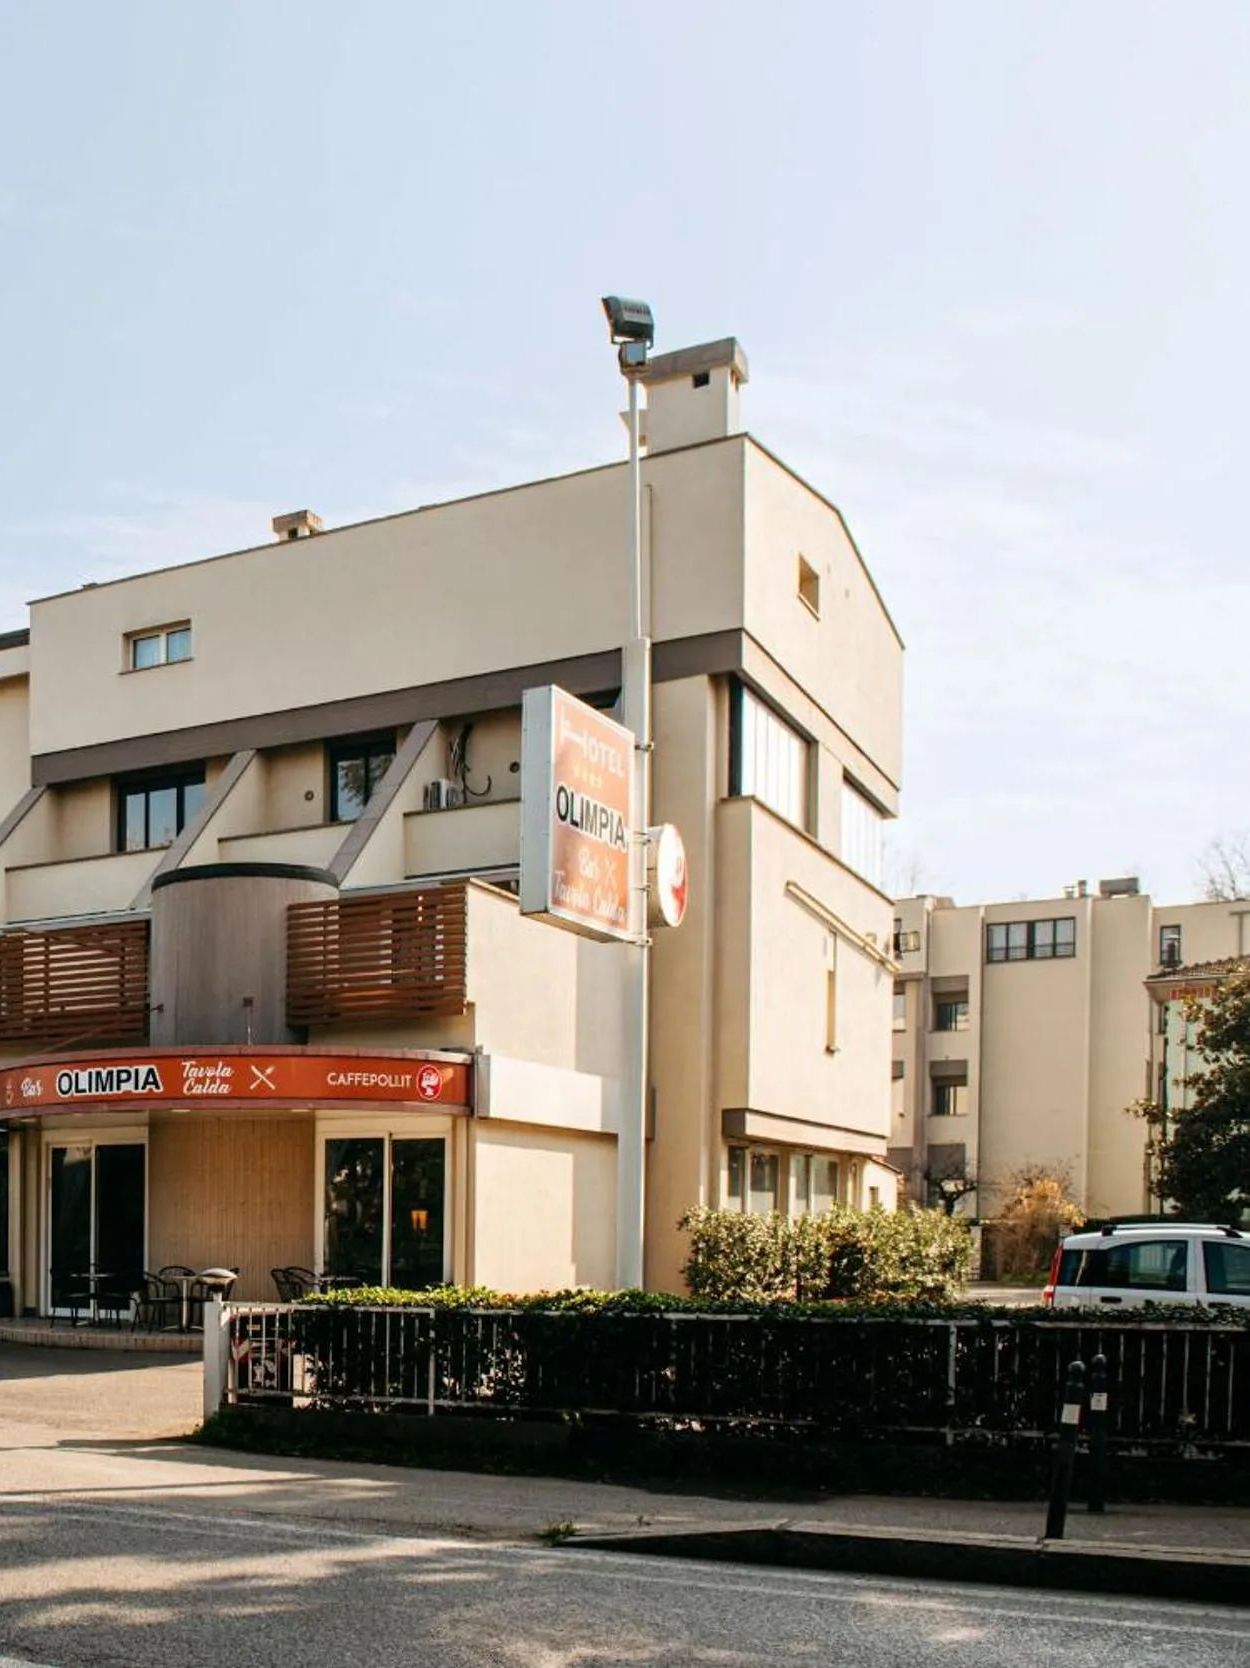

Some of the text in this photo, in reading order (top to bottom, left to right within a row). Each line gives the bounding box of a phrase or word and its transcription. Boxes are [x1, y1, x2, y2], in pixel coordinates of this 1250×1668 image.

[560, 704, 625, 778] HOTEL
[556, 785, 626, 849] OLIMPIA
[57, 1067, 162, 1096] OLIMPIA
[181, 1060, 234, 1078] Tavola
[183, 1078, 231, 1095] Calda
